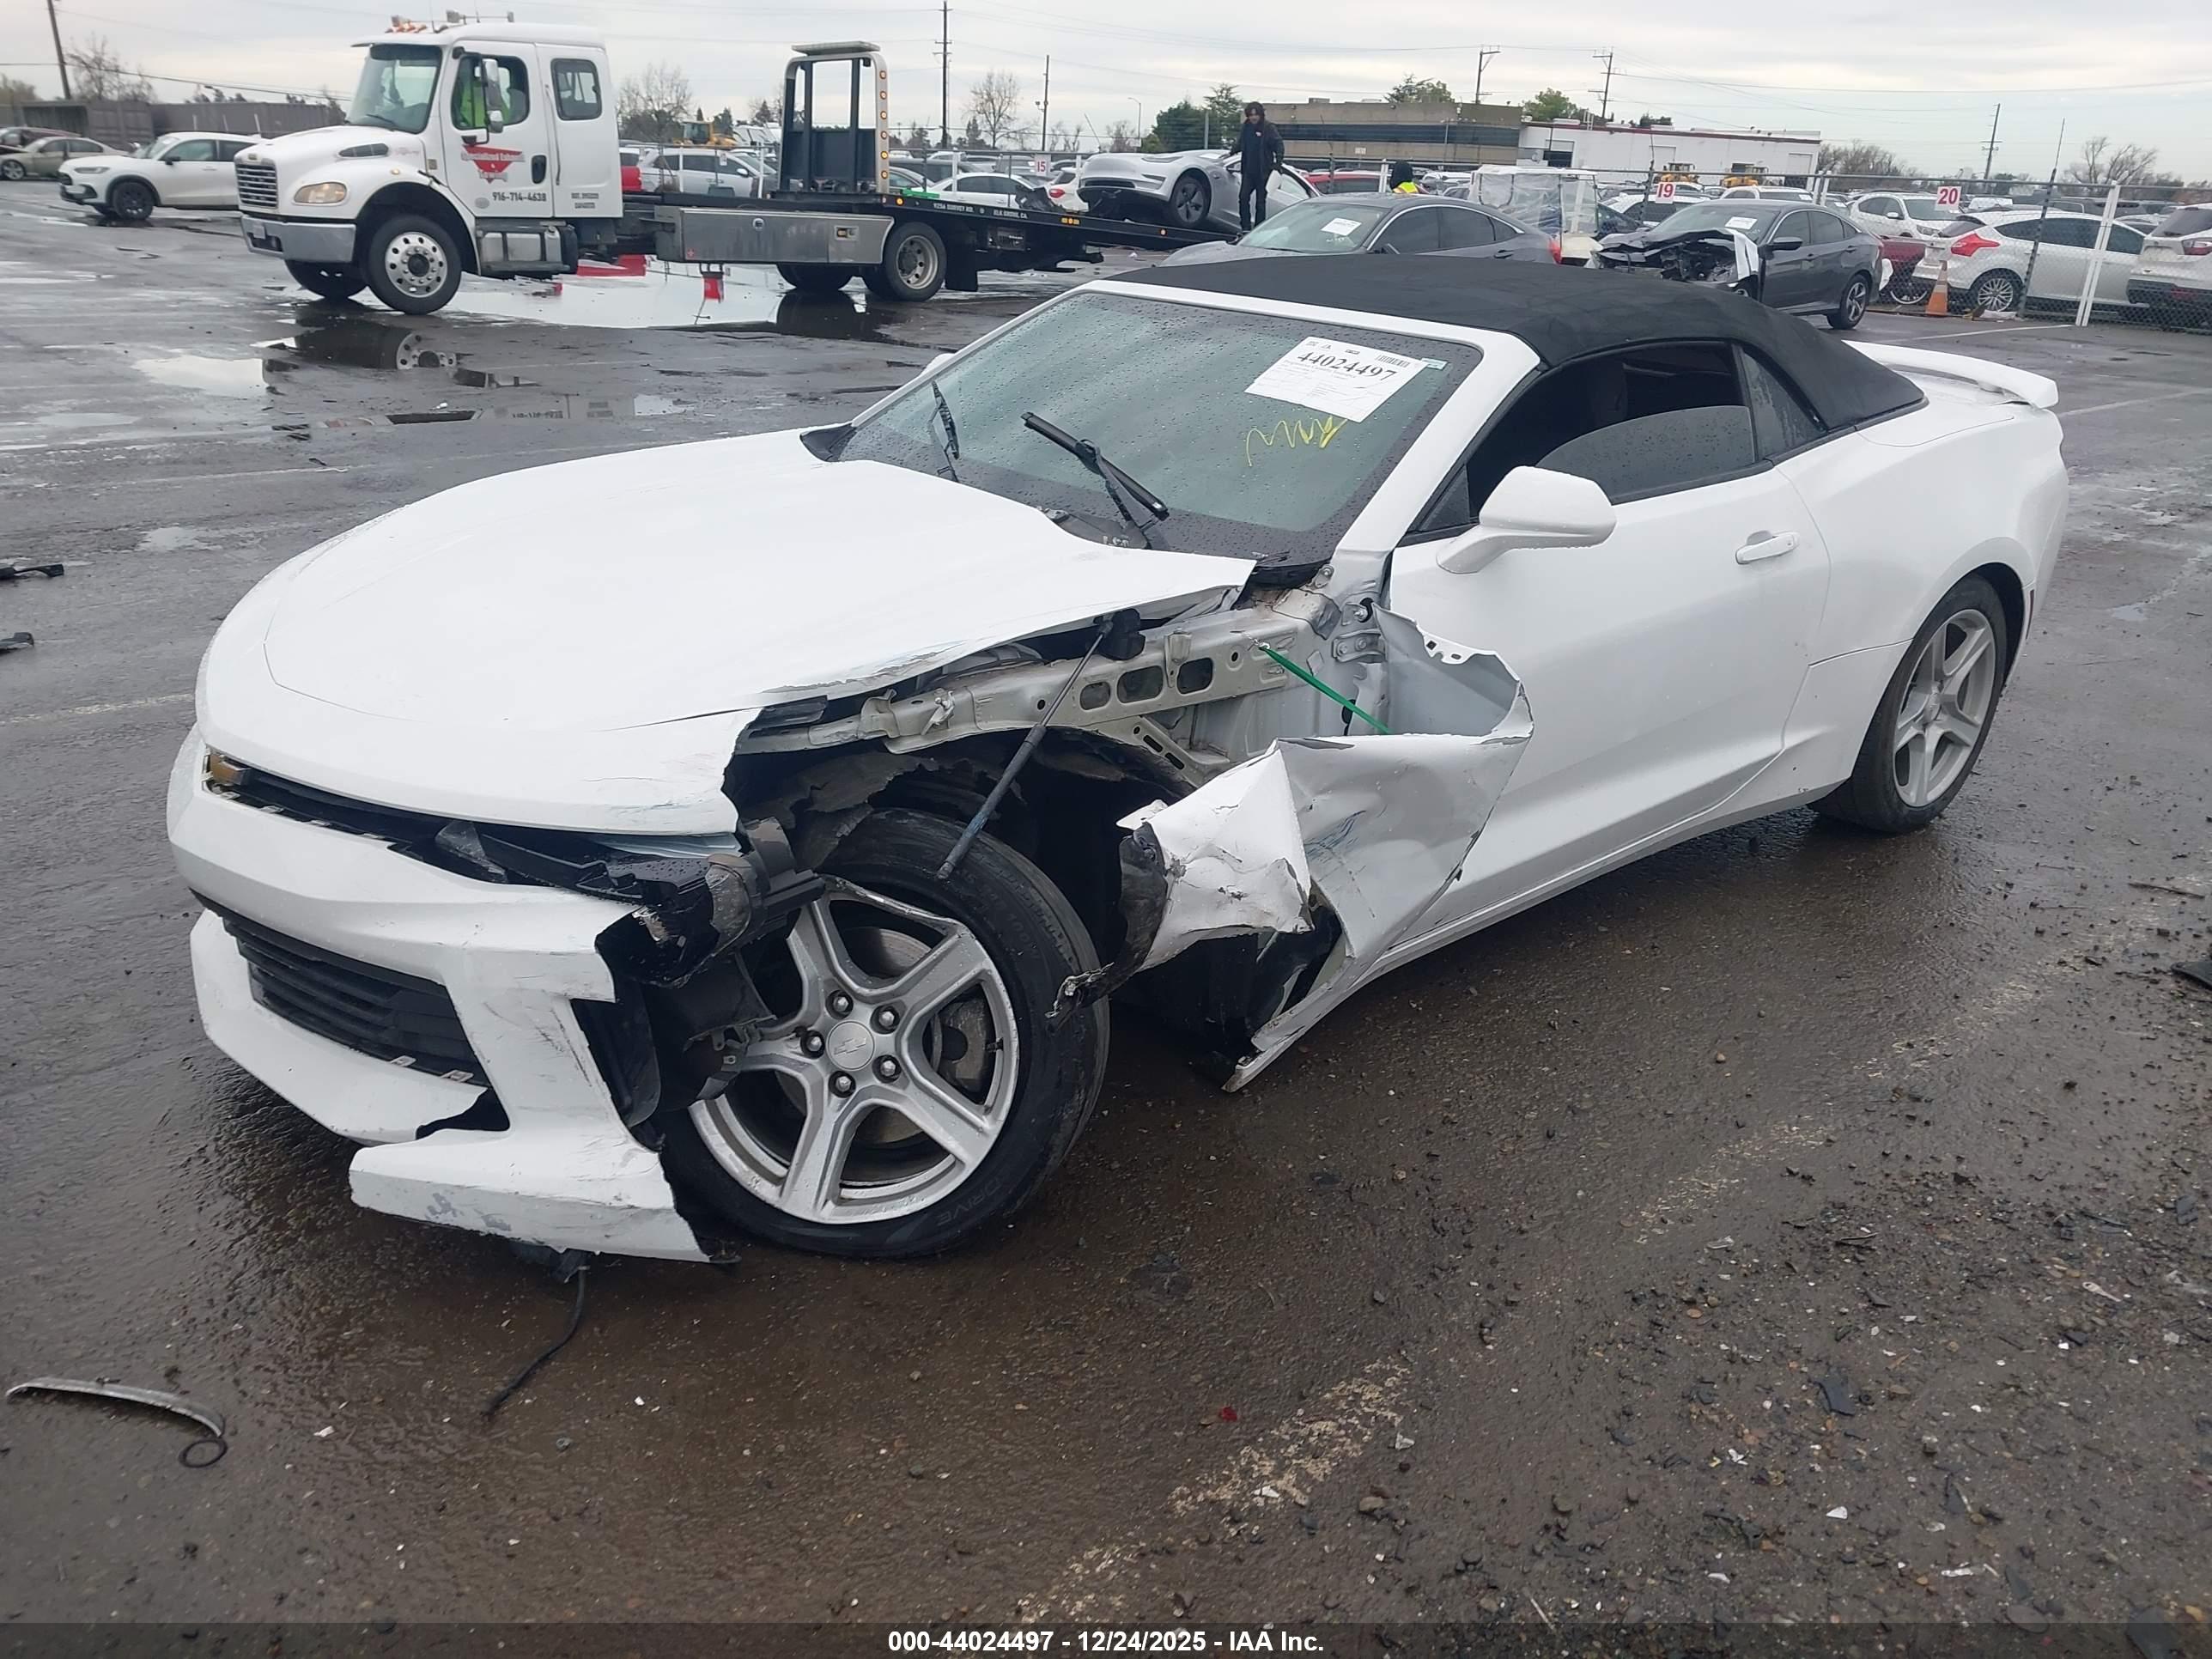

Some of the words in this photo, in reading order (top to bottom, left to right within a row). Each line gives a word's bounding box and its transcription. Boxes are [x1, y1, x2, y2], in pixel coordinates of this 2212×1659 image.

[1037, 161, 1046, 173] 15
[492, 191, 547, 202] 916-714-4638
[1657, 183, 1674, 198] 19
[1938, 187, 1958, 205] 20
[1297, 351, 1397, 381] 44024497
